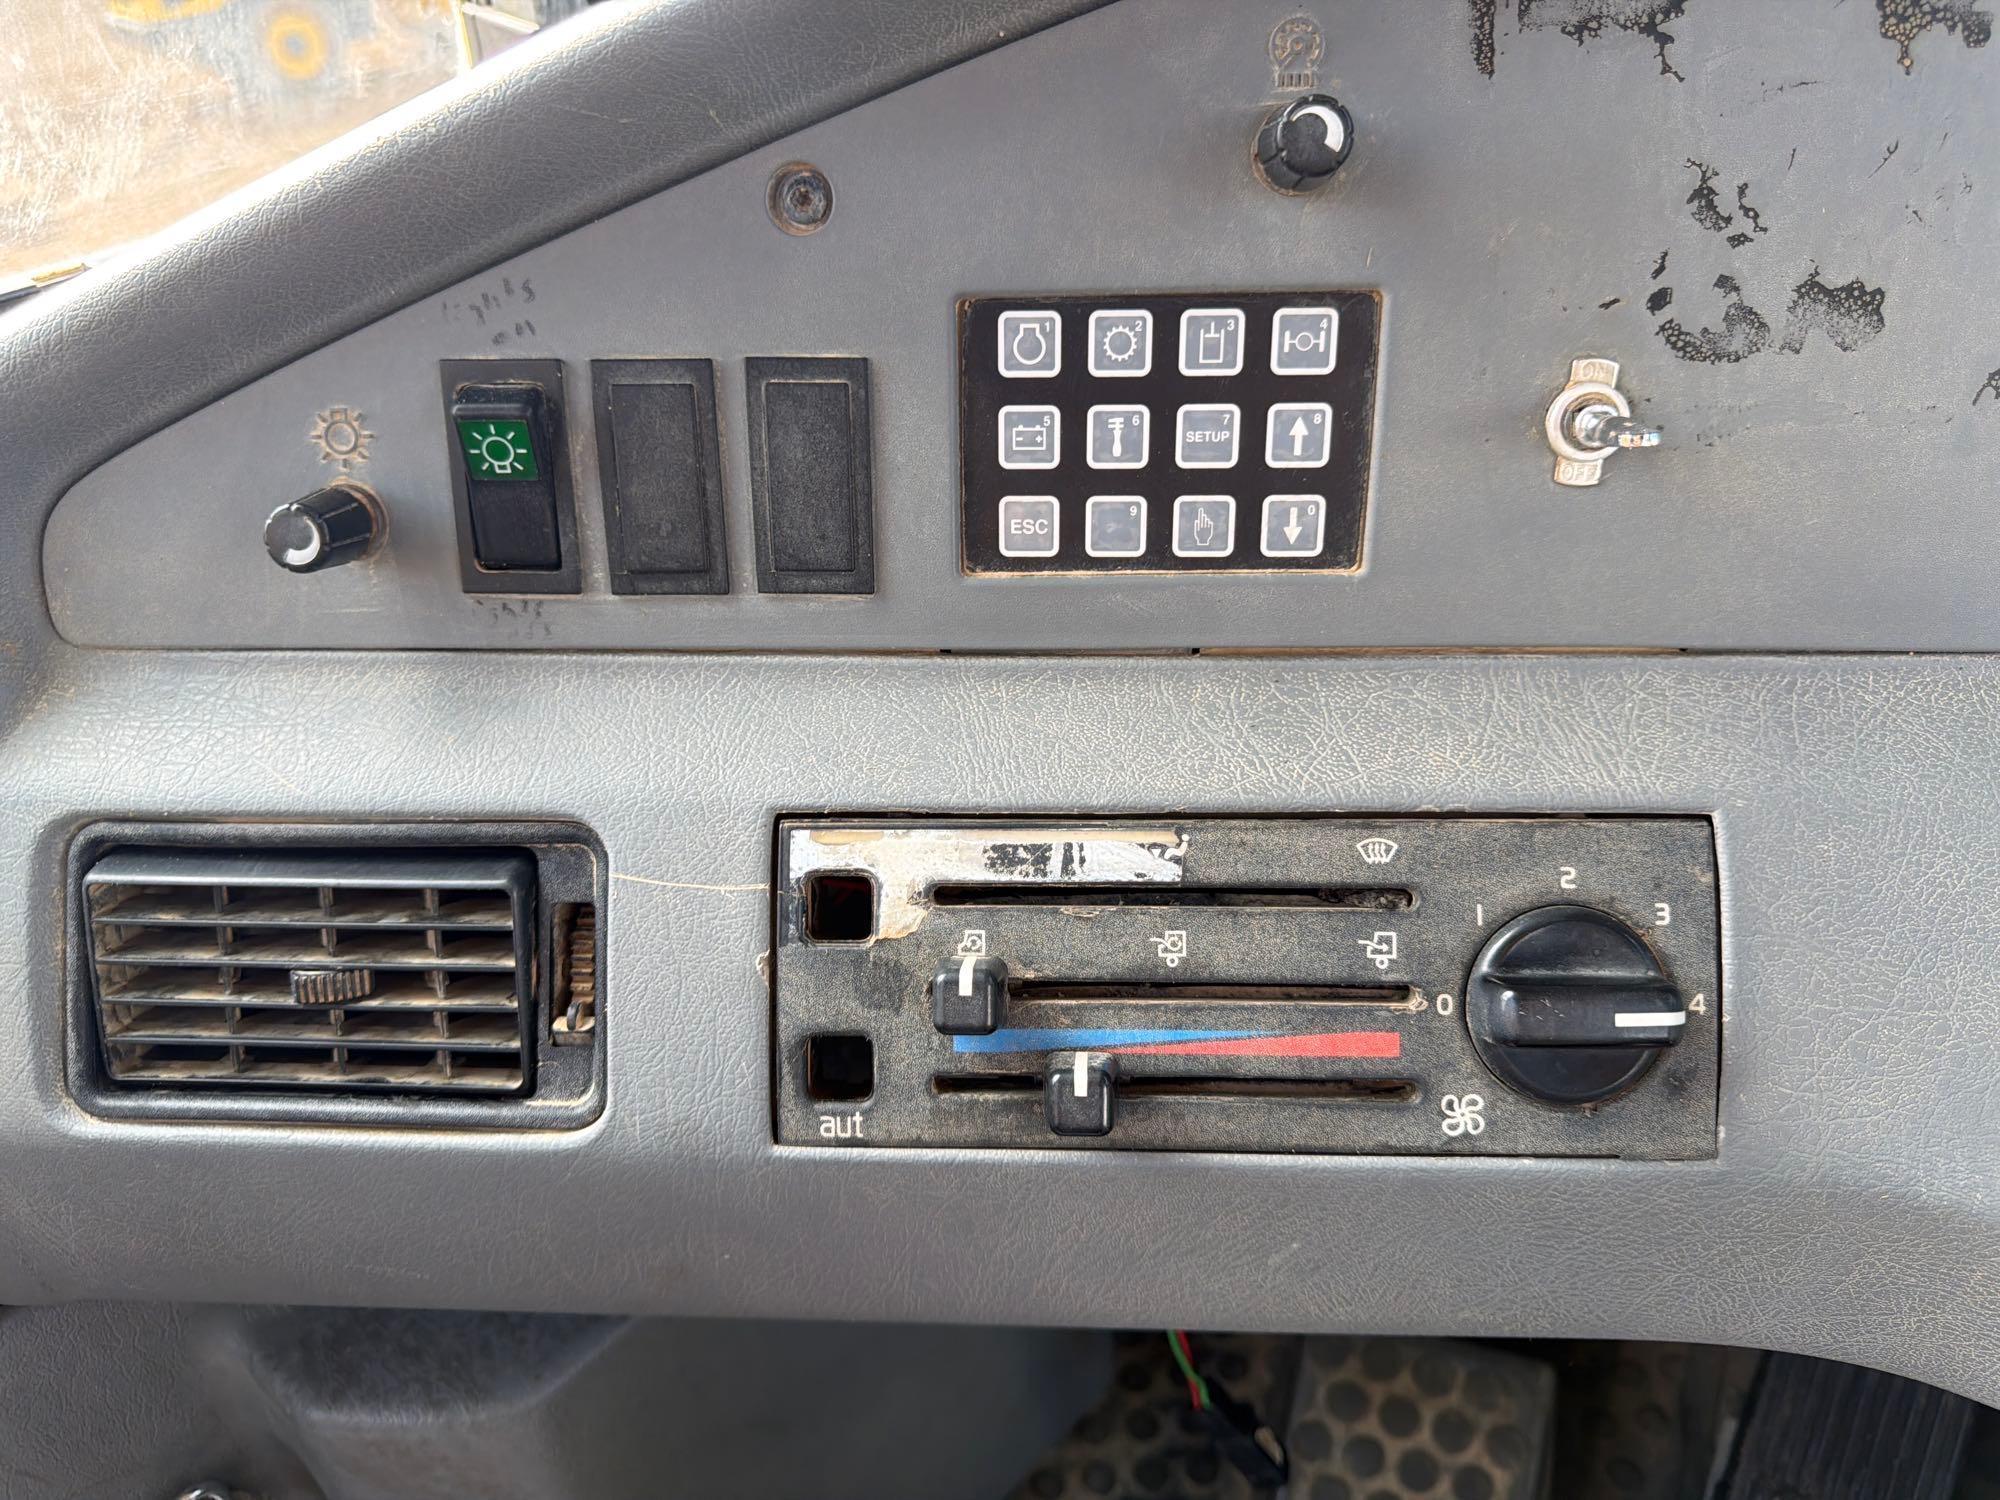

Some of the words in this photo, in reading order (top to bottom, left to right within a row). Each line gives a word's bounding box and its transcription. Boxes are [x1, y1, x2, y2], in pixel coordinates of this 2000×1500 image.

[1044, 321, 1050, 333] 1
[1134, 320, 1143, 332] 2
[1226, 318, 1235, 331] 3
[1319, 318, 1329, 330] 4
[1580, 363, 1608, 379] ON
[1043, 415, 1051, 427] 5
[1132, 414, 1140, 426] 6
[1223, 413, 1231, 425] 7
[1313, 412, 1322, 424] 8
[1185, 430, 1230, 443] SETUP
[1561, 464, 1597, 481] OFF
[1129, 505, 1137, 517] 9
[1307, 504, 1316, 516] 0
[1009, 518, 1049, 535] ESC
[1559, 866, 1577, 889] 2
[1476, 903, 1484, 927] 1
[1655, 902, 1671, 926] 3
[1436, 993, 1453, 1016] 0
[1688, 993, 1707, 1015] 4
[819, 1111, 864, 1139] aut
